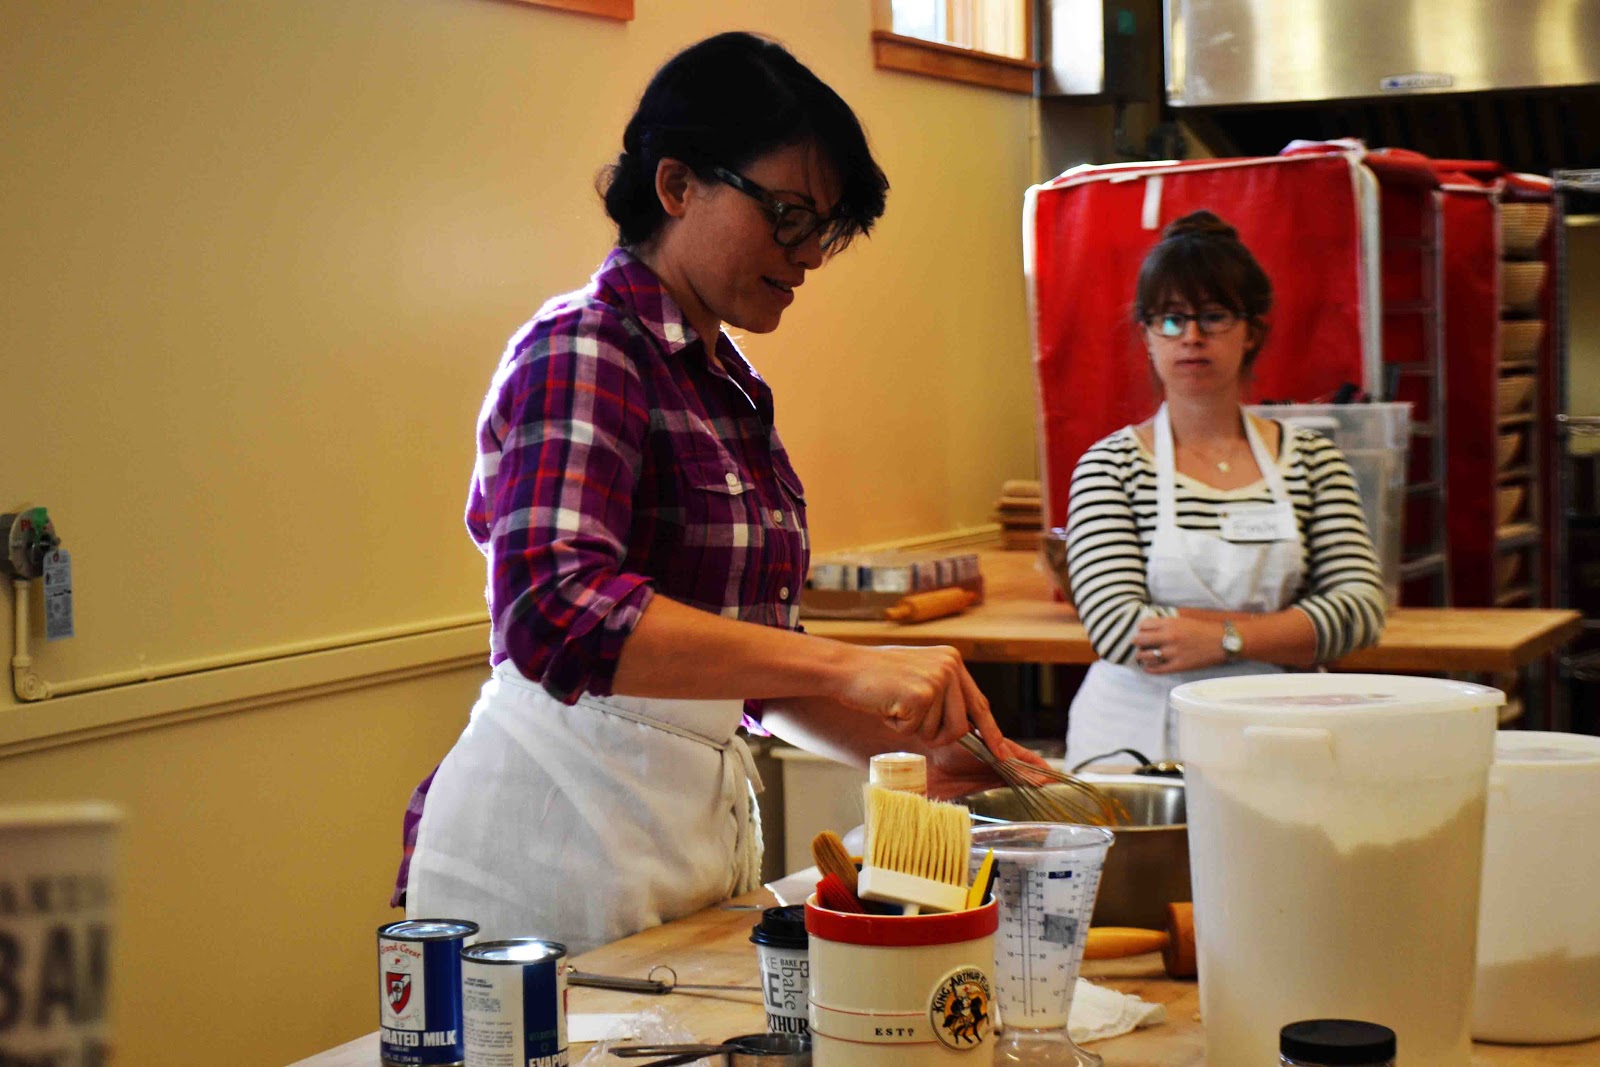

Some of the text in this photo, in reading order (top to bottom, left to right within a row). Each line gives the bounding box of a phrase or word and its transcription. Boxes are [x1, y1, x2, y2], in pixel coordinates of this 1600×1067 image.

[780, 958, 798, 967] BAKE
[781, 967, 803, 1010] bake
[932, 987, 950, 1013] KING
[949, 971, 981, 987] ARTHUR
[423, 1029, 457, 1047] MILK
